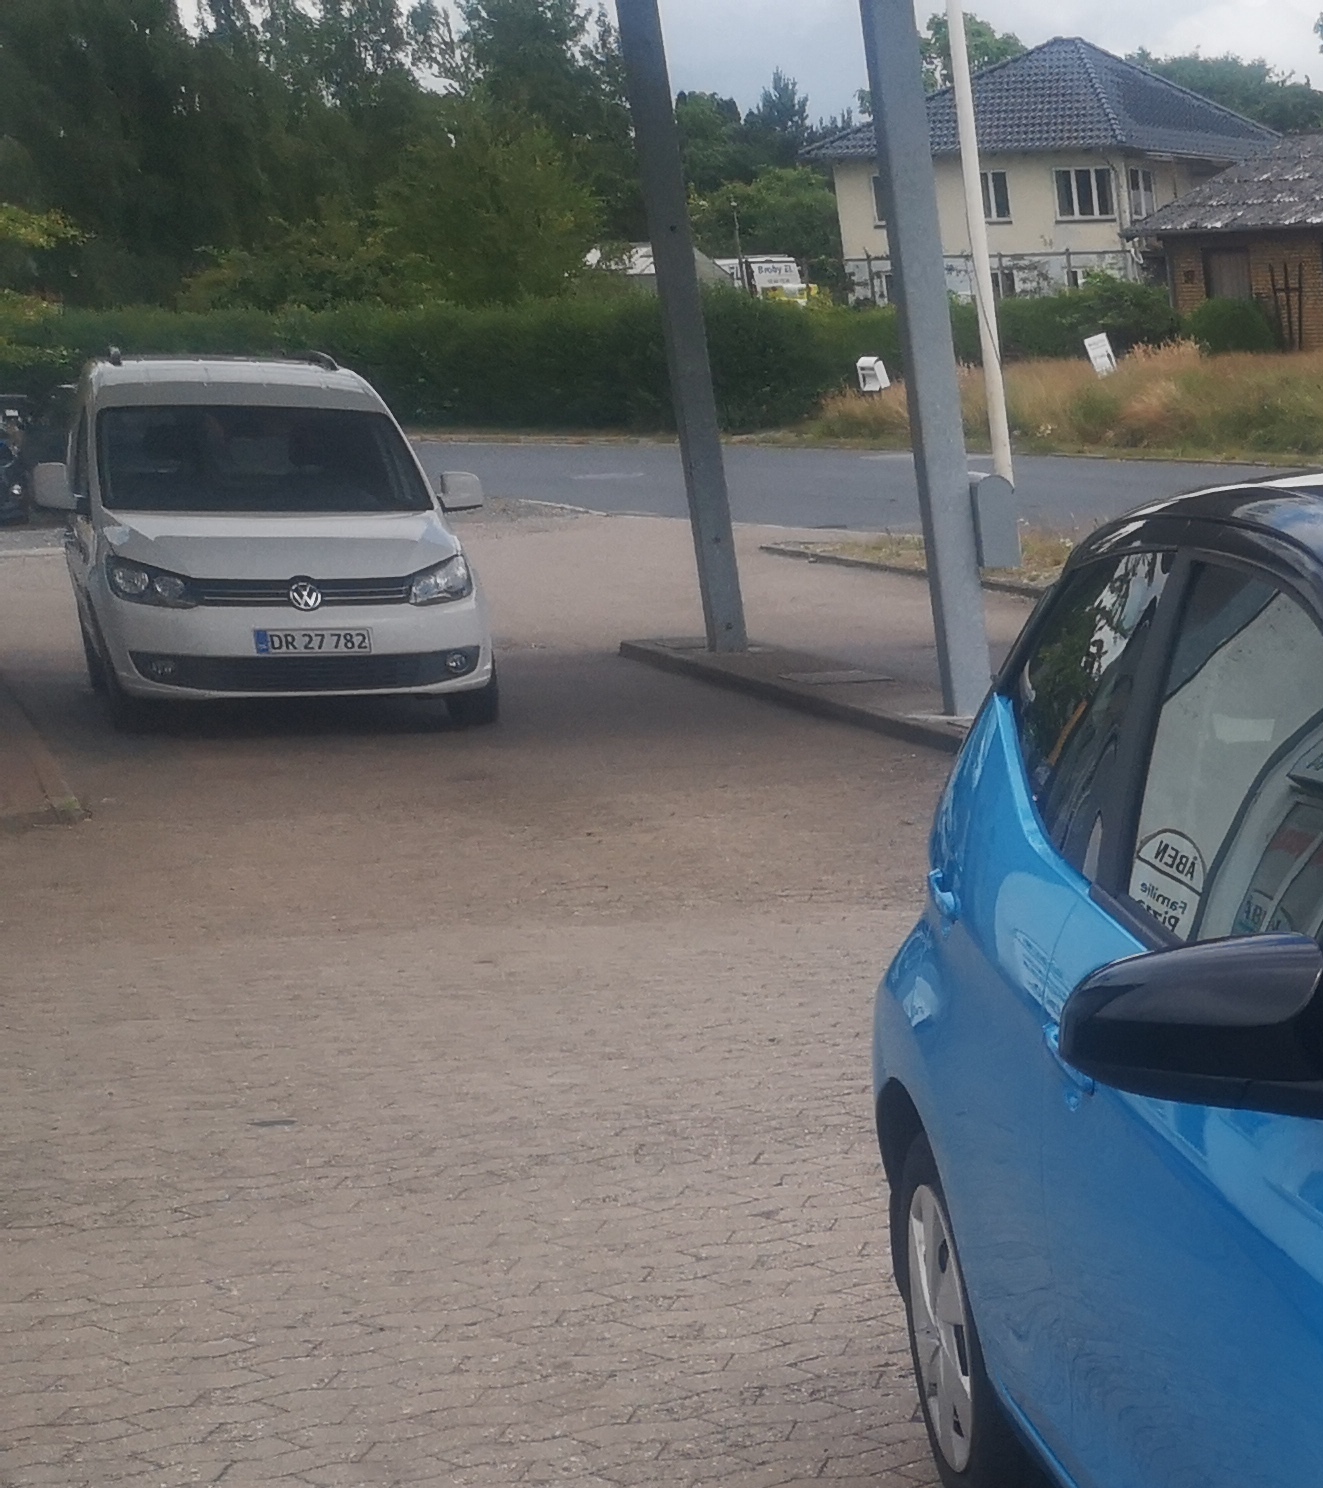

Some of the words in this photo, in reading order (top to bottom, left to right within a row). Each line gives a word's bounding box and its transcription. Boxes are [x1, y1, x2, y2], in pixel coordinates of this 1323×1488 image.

[269, 633, 297, 650] DR
[302, 633, 325, 650] 27
[330, 632, 368, 650] 782
